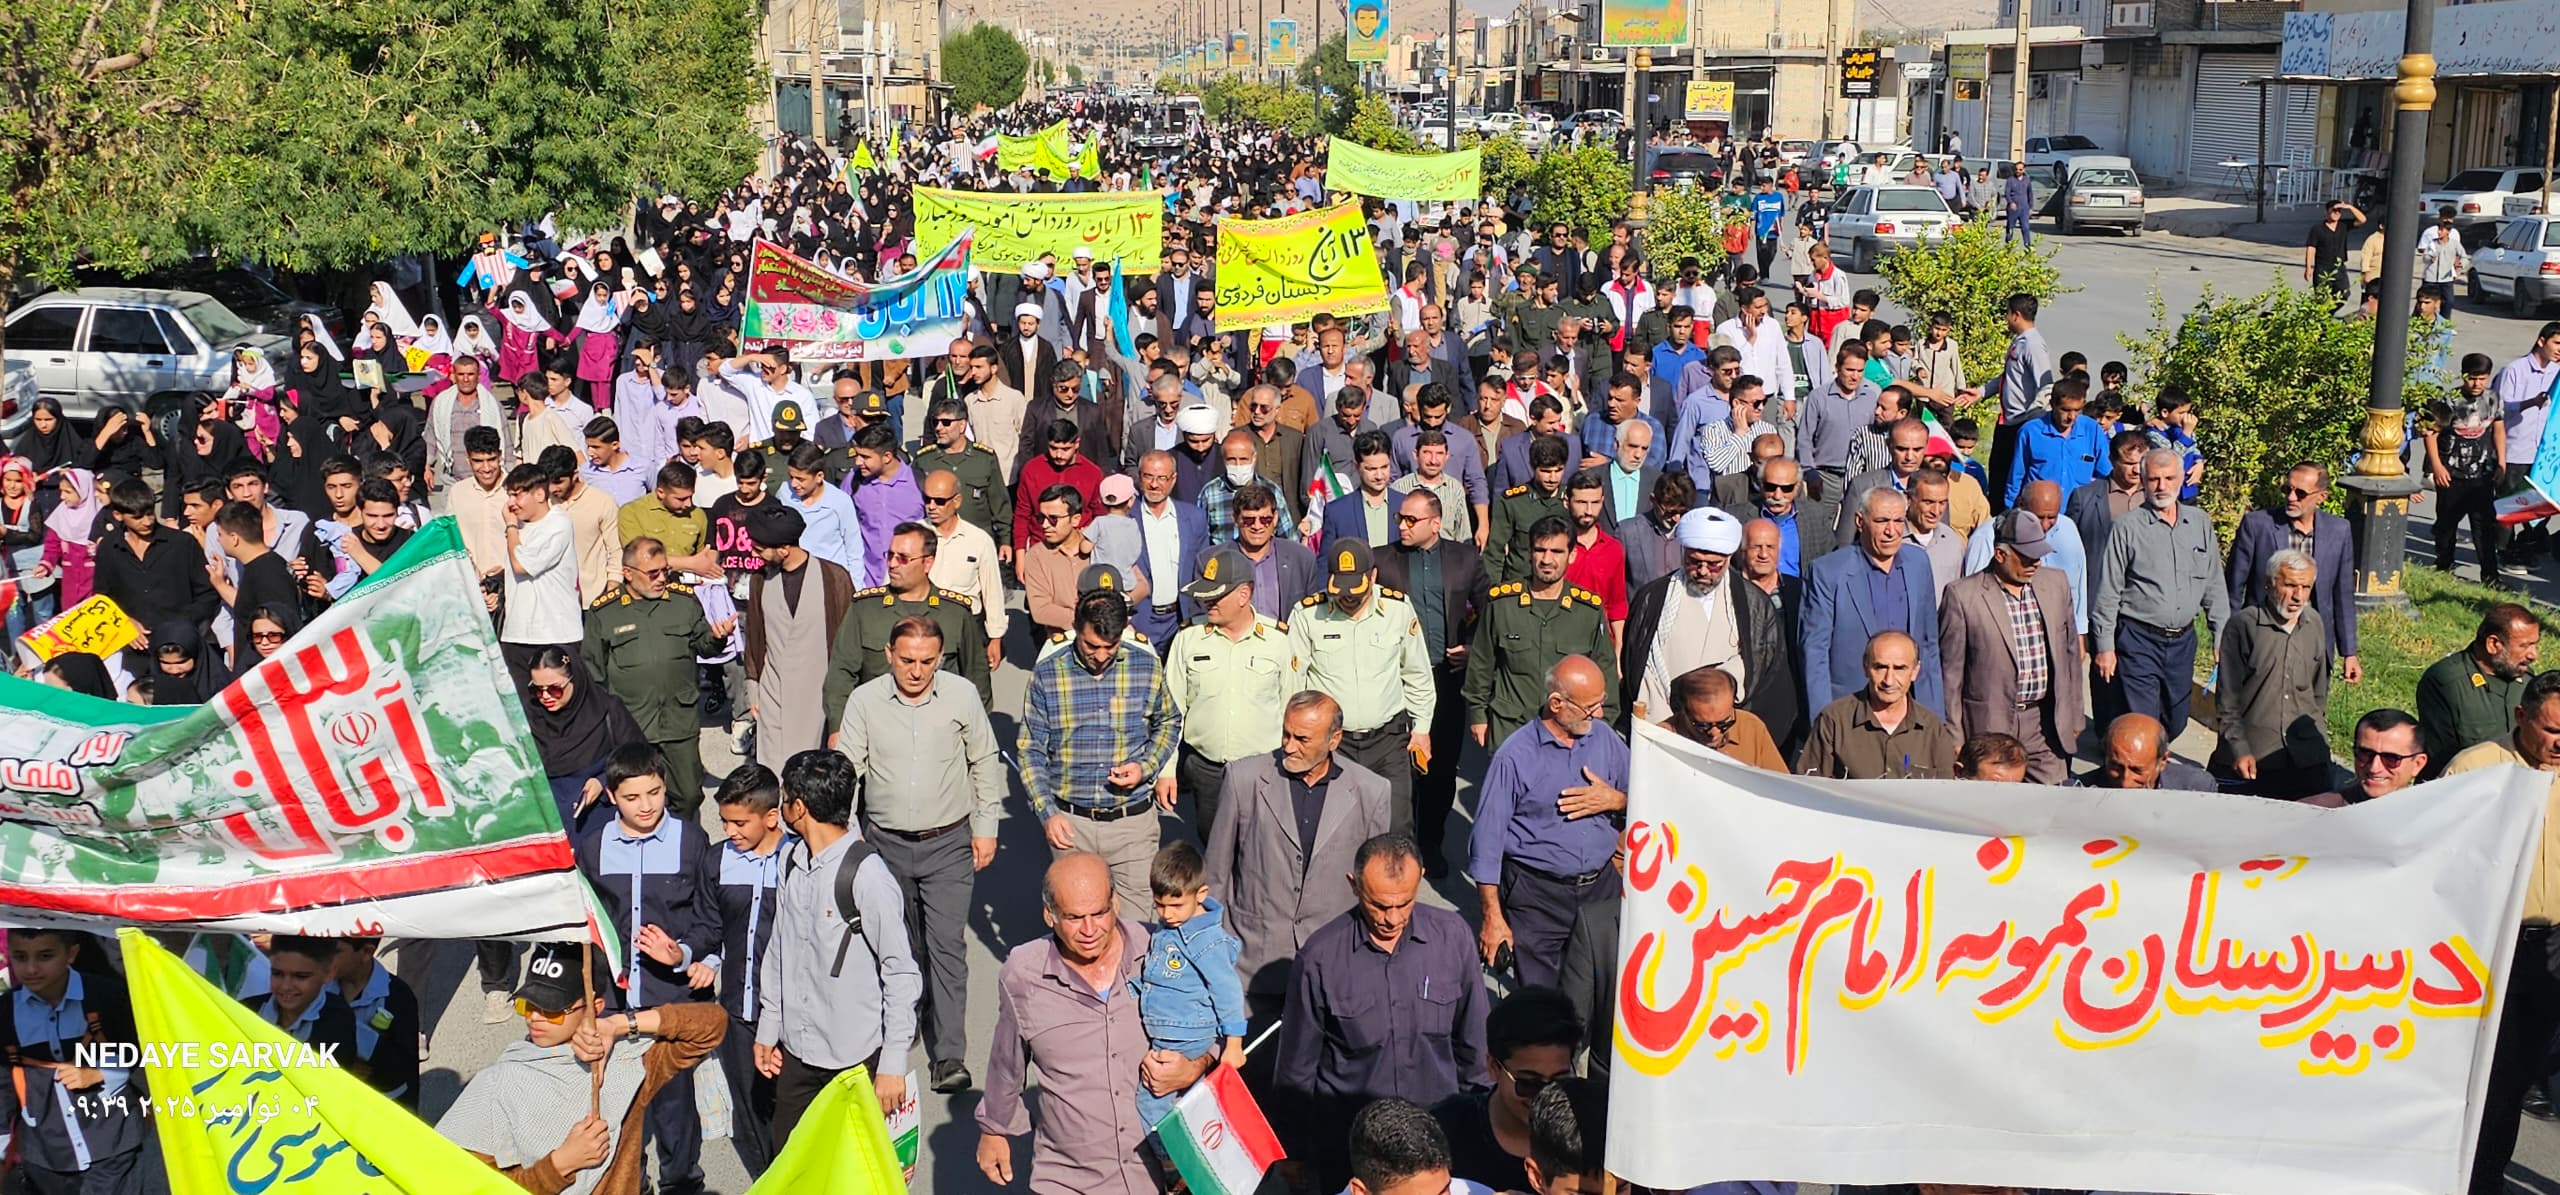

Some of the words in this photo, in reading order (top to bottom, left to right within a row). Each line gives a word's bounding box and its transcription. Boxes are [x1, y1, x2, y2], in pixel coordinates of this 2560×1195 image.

[1215, 276, 1265, 307] فردوسی
[1265, 275, 1332, 306] دبستان
[1339, 225, 1367, 260] ۱۳
[531, 949, 564, 978] alo
[1614, 857, 1837, 1077] حسین
[1786, 852, 1935, 1075] امام
[1936, 835, 2138, 1024] نمونه
[2054, 854, 2493, 1074] دبیرستان
